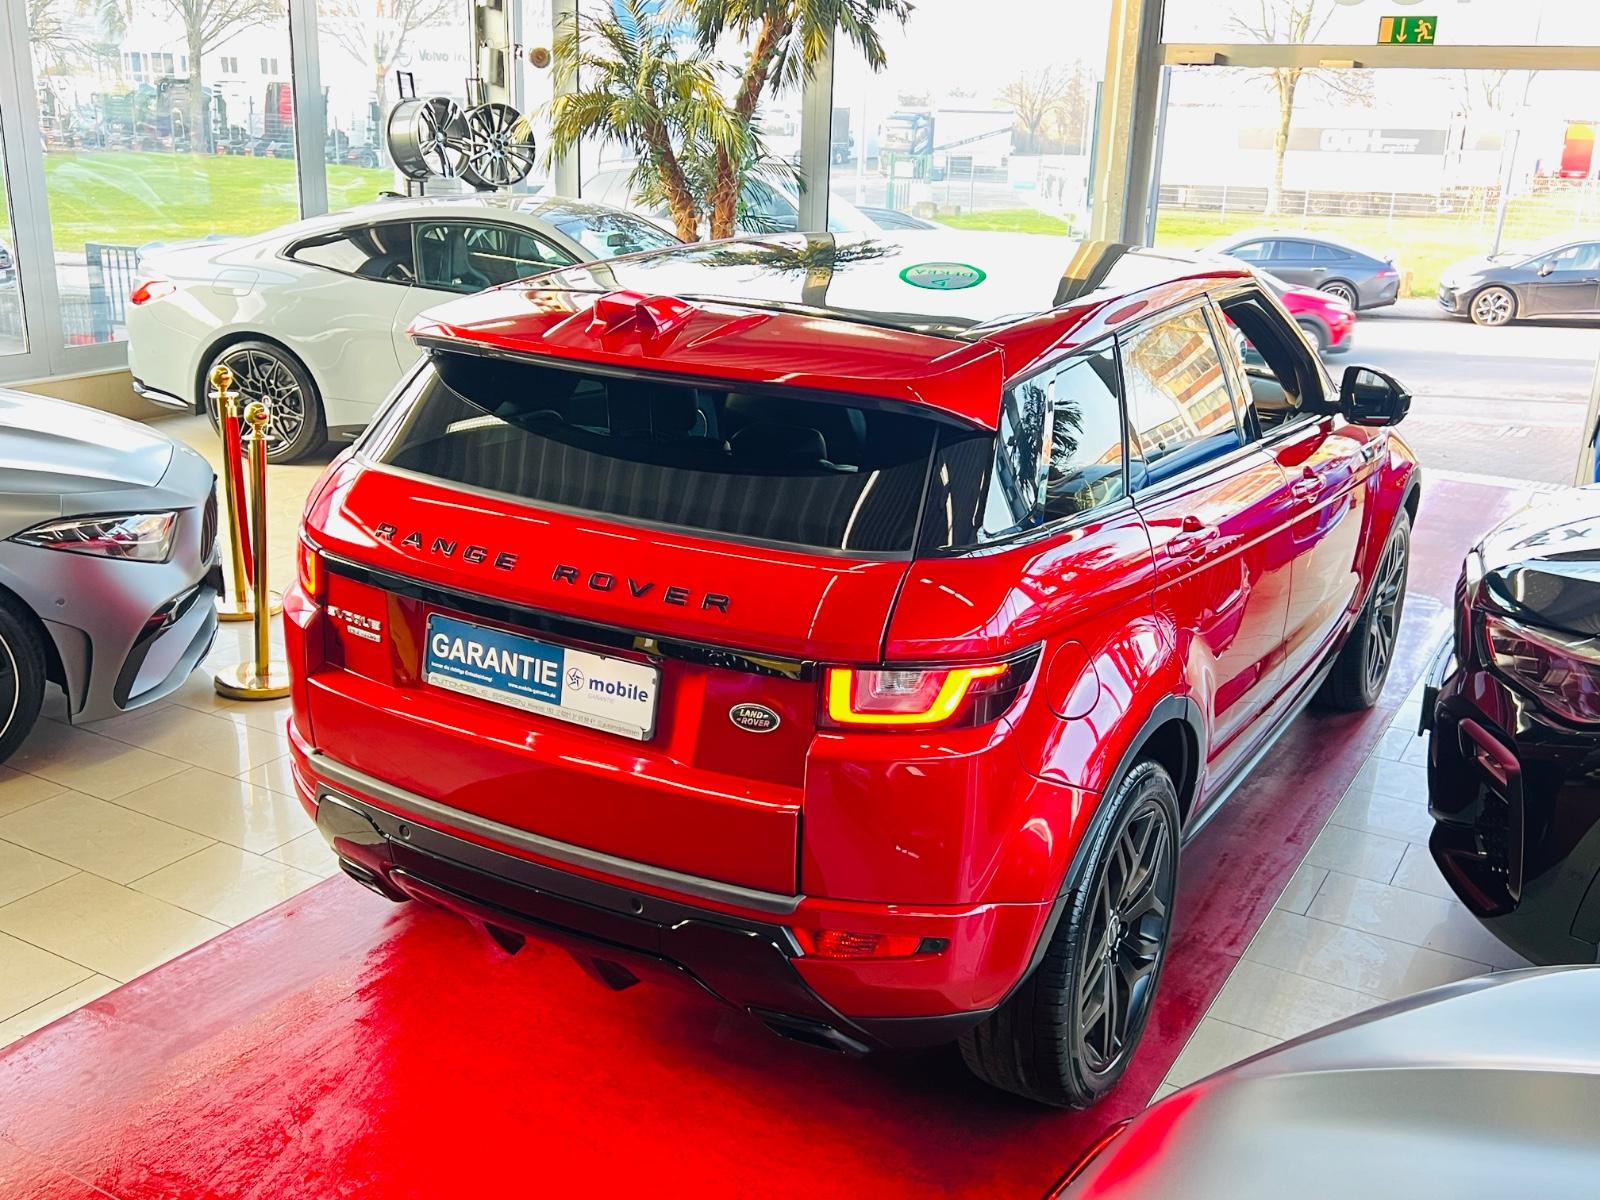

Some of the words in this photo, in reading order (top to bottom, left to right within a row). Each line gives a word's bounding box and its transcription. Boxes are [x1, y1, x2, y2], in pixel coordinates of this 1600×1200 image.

[418, 48, 449, 62] Volvo
[374, 522, 519, 571] RANGE
[551, 563, 730, 614] ROVER
[431, 633, 558, 688] GARANTIE
[588, 677, 649, 703] mobile
